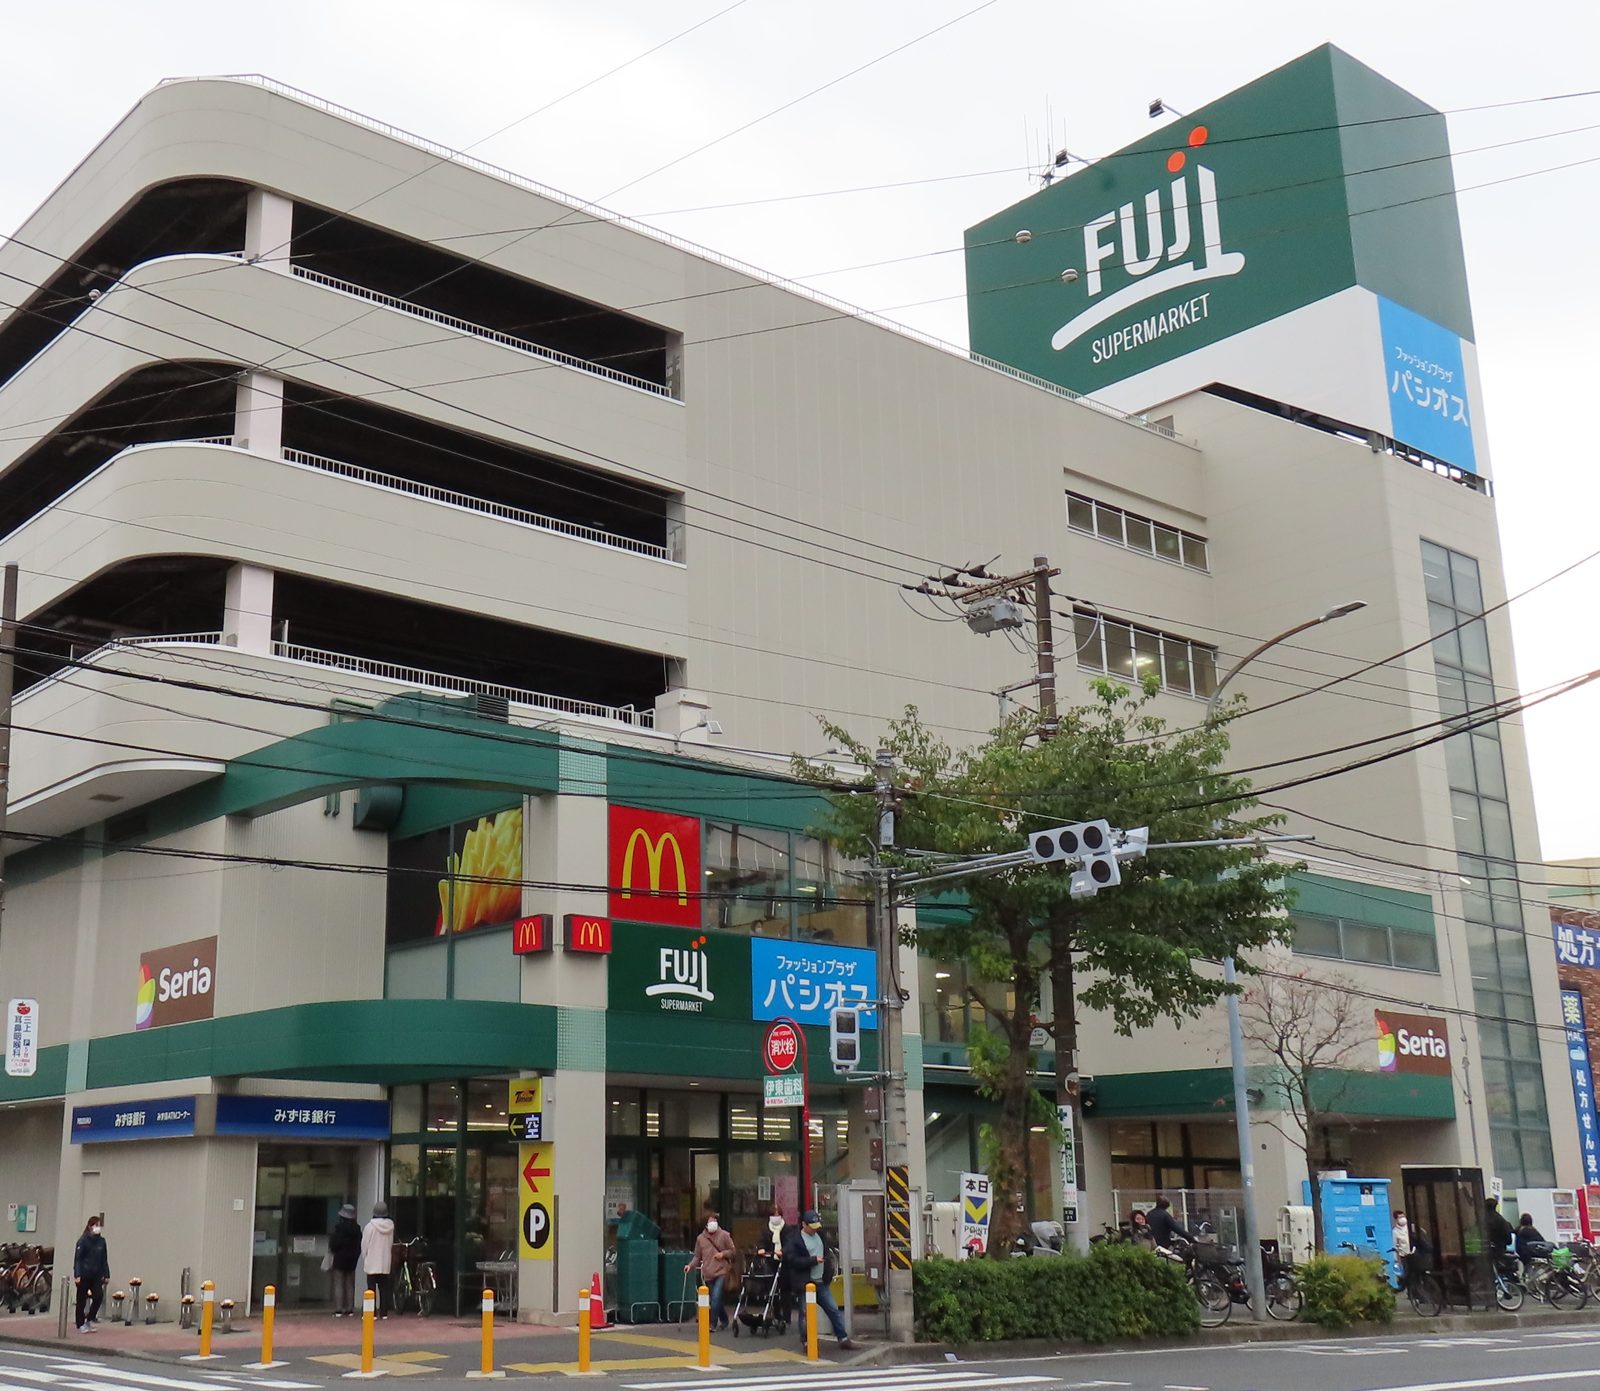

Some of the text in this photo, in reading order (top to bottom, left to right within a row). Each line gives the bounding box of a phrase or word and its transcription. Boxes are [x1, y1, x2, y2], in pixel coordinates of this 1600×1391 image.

[1083, 126, 1225, 298] FUJI
[1092, 292, 1210, 364] SUPERMARKET
[1395, 346, 1454, 383] ファッションプラザ
[1391, 370, 1469, 427] パシオス
[1557, 926, 1600, 966] 処方
[659, 935, 709, 993] FUJI
[776, 955, 857, 977] ファッションプラザ
[158, 957, 212, 1002] Seria
[660, 998, 703, 1013] SUPERMARKET
[763, 976, 873, 1016] パシオス
[1562, 995, 1581, 1024] 薬
[771, 1038, 795, 1056] 消火栓
[1397, 1028, 1447, 1058] Seria
[766, 1078, 803, 1096] 伊東歯科
[114, 1111, 147, 1127] みずほ銀行
[273, 1108, 337, 1125] みずほ銀行
[525, 1114, 540, 1140] 空
[965, 1178, 989, 1193] 本日
[529, 1208, 546, 1243] P
